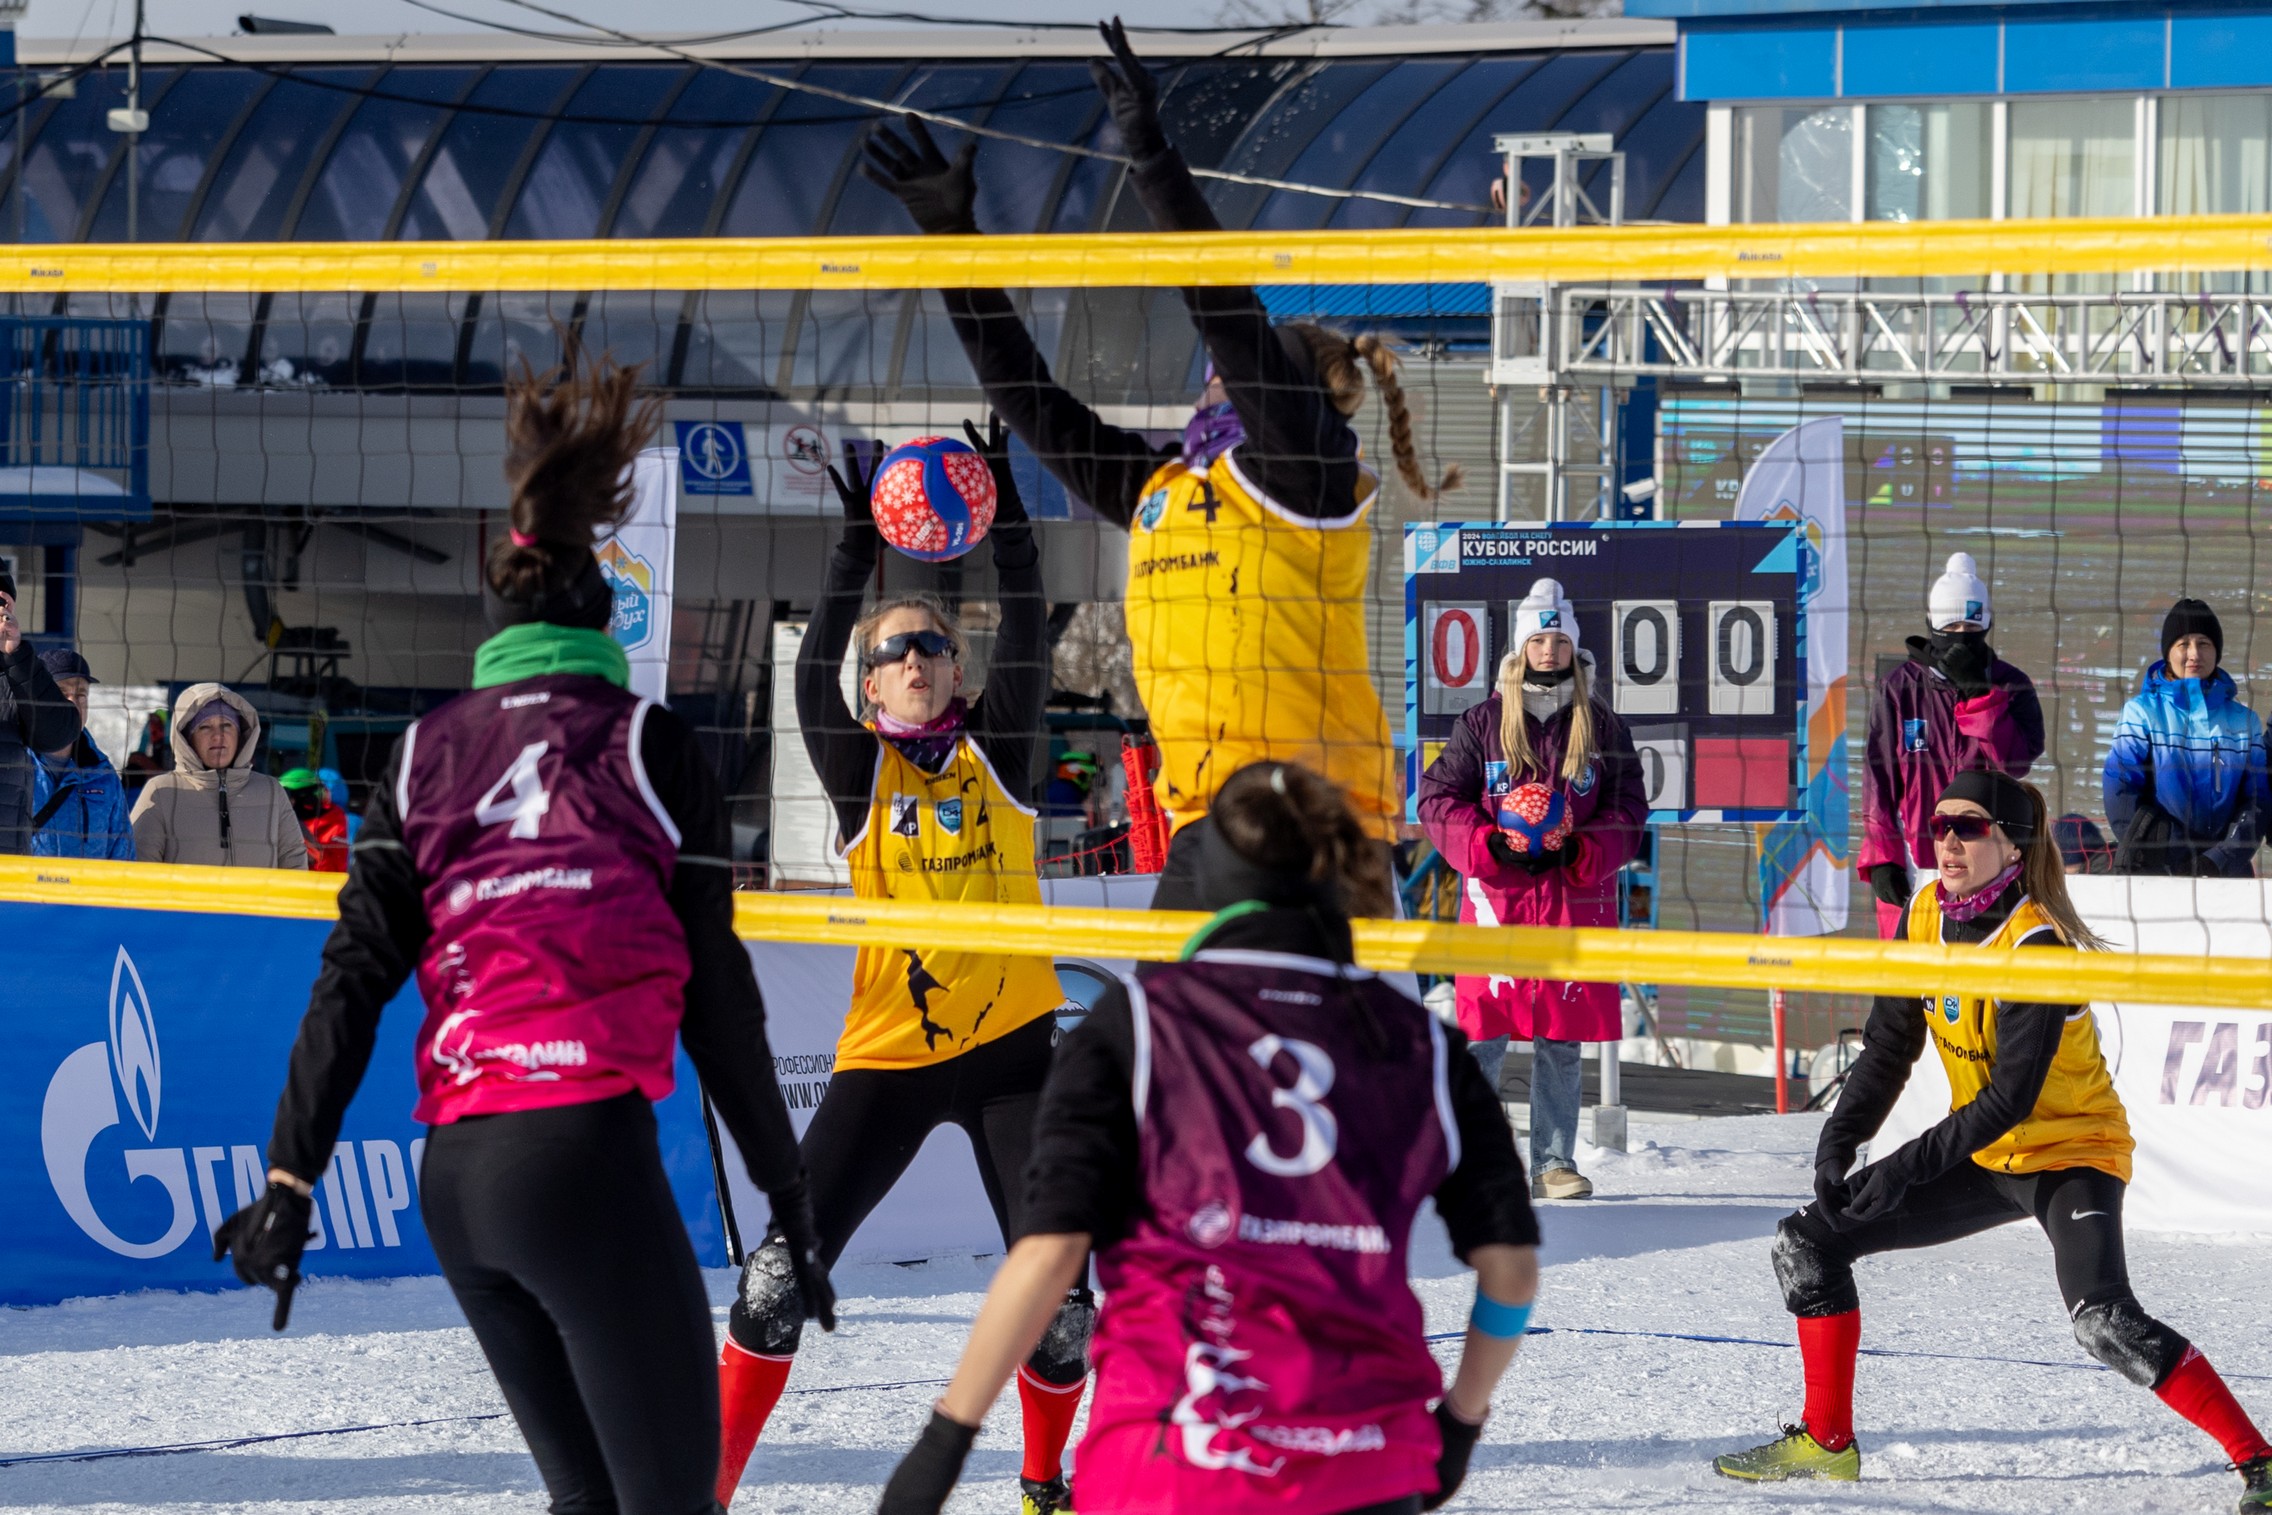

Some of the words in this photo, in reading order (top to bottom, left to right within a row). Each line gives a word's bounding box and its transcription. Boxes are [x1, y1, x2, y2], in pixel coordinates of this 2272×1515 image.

[1186, 480, 1222, 522] 4
[1430, 560, 1457, 571] ВФВ
[1462, 558, 1532, 567] ЮЖНО-САХАЛИНСК
[1463, 541, 1520, 557] КУБОК
[1525, 541, 1597, 557] РОССИИ
[1520, 532, 1530, 540] НА
[1432, 609, 1480, 688] 0
[1623, 605, 1669, 686] 0
[1718, 605, 1765, 686] 0
[475, 740, 550, 840] 4
[773, 1053, 837, 1075] РОФЕССИОН
[2159, 1020, 2272, 1110] ГАЗ
[1245, 1034, 1338, 1177] 3
[192, 1138, 428, 1255] ГАПР
